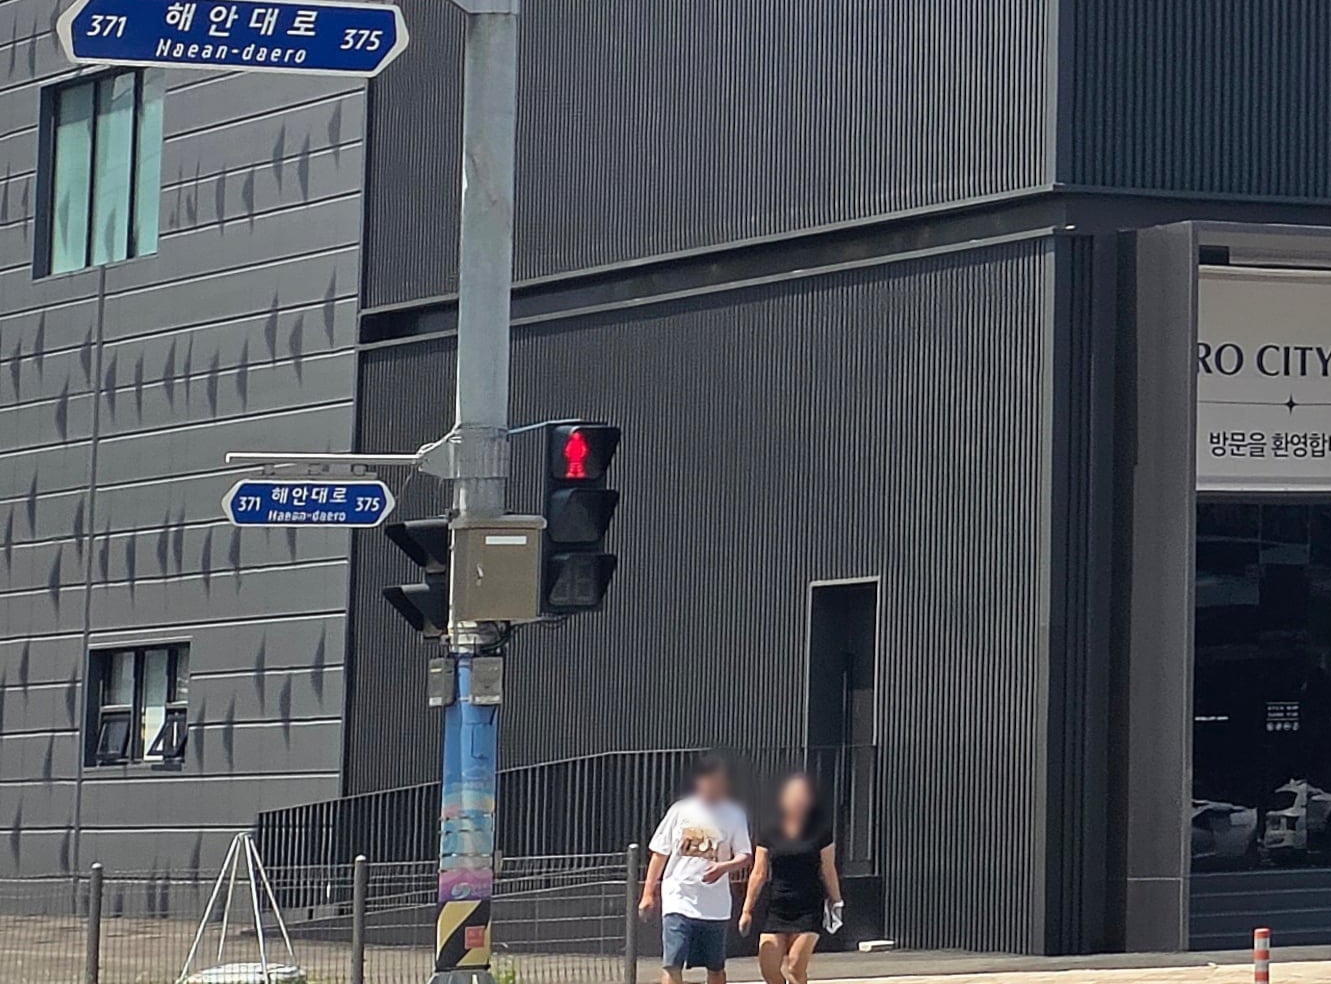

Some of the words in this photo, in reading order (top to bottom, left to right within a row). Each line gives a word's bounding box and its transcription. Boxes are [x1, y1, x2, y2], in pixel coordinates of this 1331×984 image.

[87, 15, 127, 38] 371
[165, 2, 319, 37] 해안대로
[340, 29, 384, 51] 375
[156, 38, 307, 64] Haean-daero
[1209, 431, 1267, 458] 방문을
[238, 496, 261, 512] 371
[271, 487, 347, 506] 해안대로
[354, 497, 380, 512] 375
